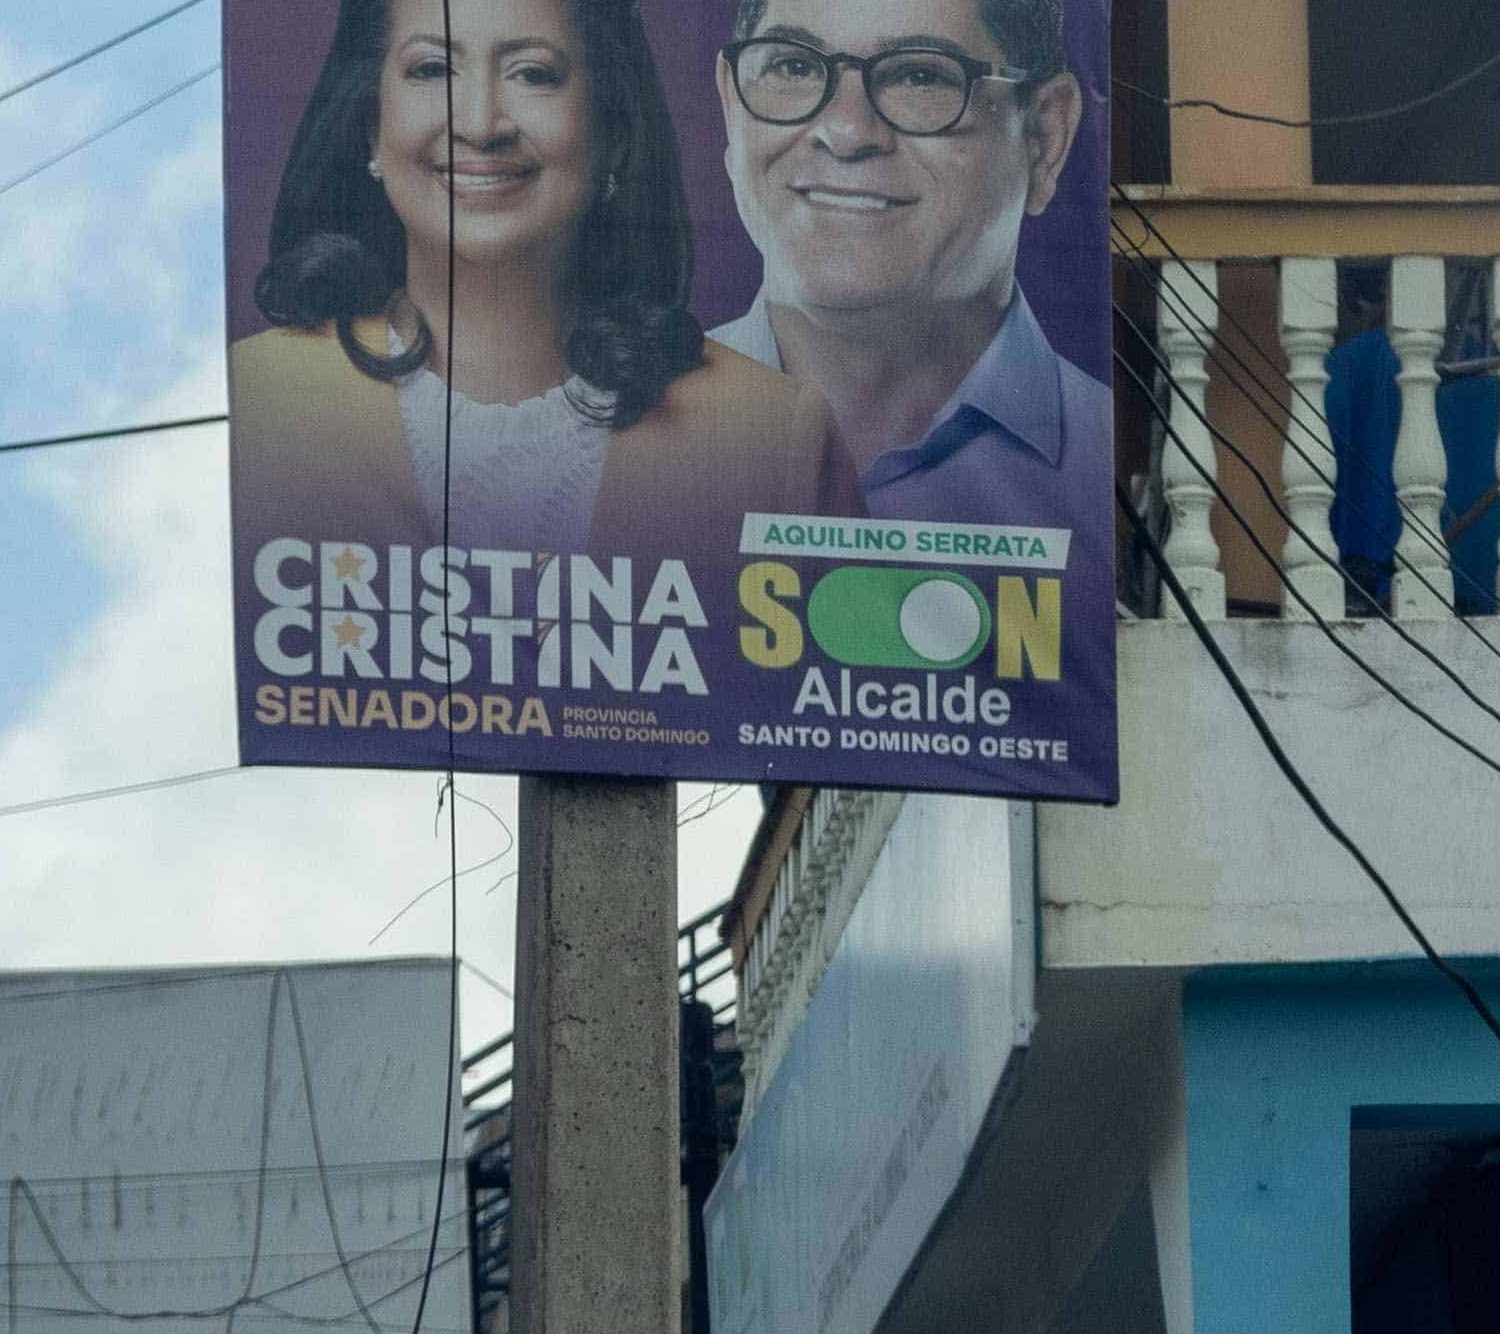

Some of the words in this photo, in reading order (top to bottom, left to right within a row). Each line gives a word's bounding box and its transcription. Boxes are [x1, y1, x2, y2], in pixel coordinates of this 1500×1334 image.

[763, 523, 907, 552] AQUILINO
[915, 530, 1048, 559] SERRATA
[252, 537, 709, 628] CRISTINA
[252, 605, 709, 696] CRISTINA
[254, 683, 553, 737] SENADORA
[562, 705, 658, 726] PROVINCIA
[792, 666, 1012, 726] Alcalde
[562, 723, 622, 742] SANTO
[624, 726, 710, 746] DOMINGO
[738, 723, 831, 748] SANTO
[840, 730, 970, 756] DOMINGO
[979, 736, 1069, 762] OESTE
